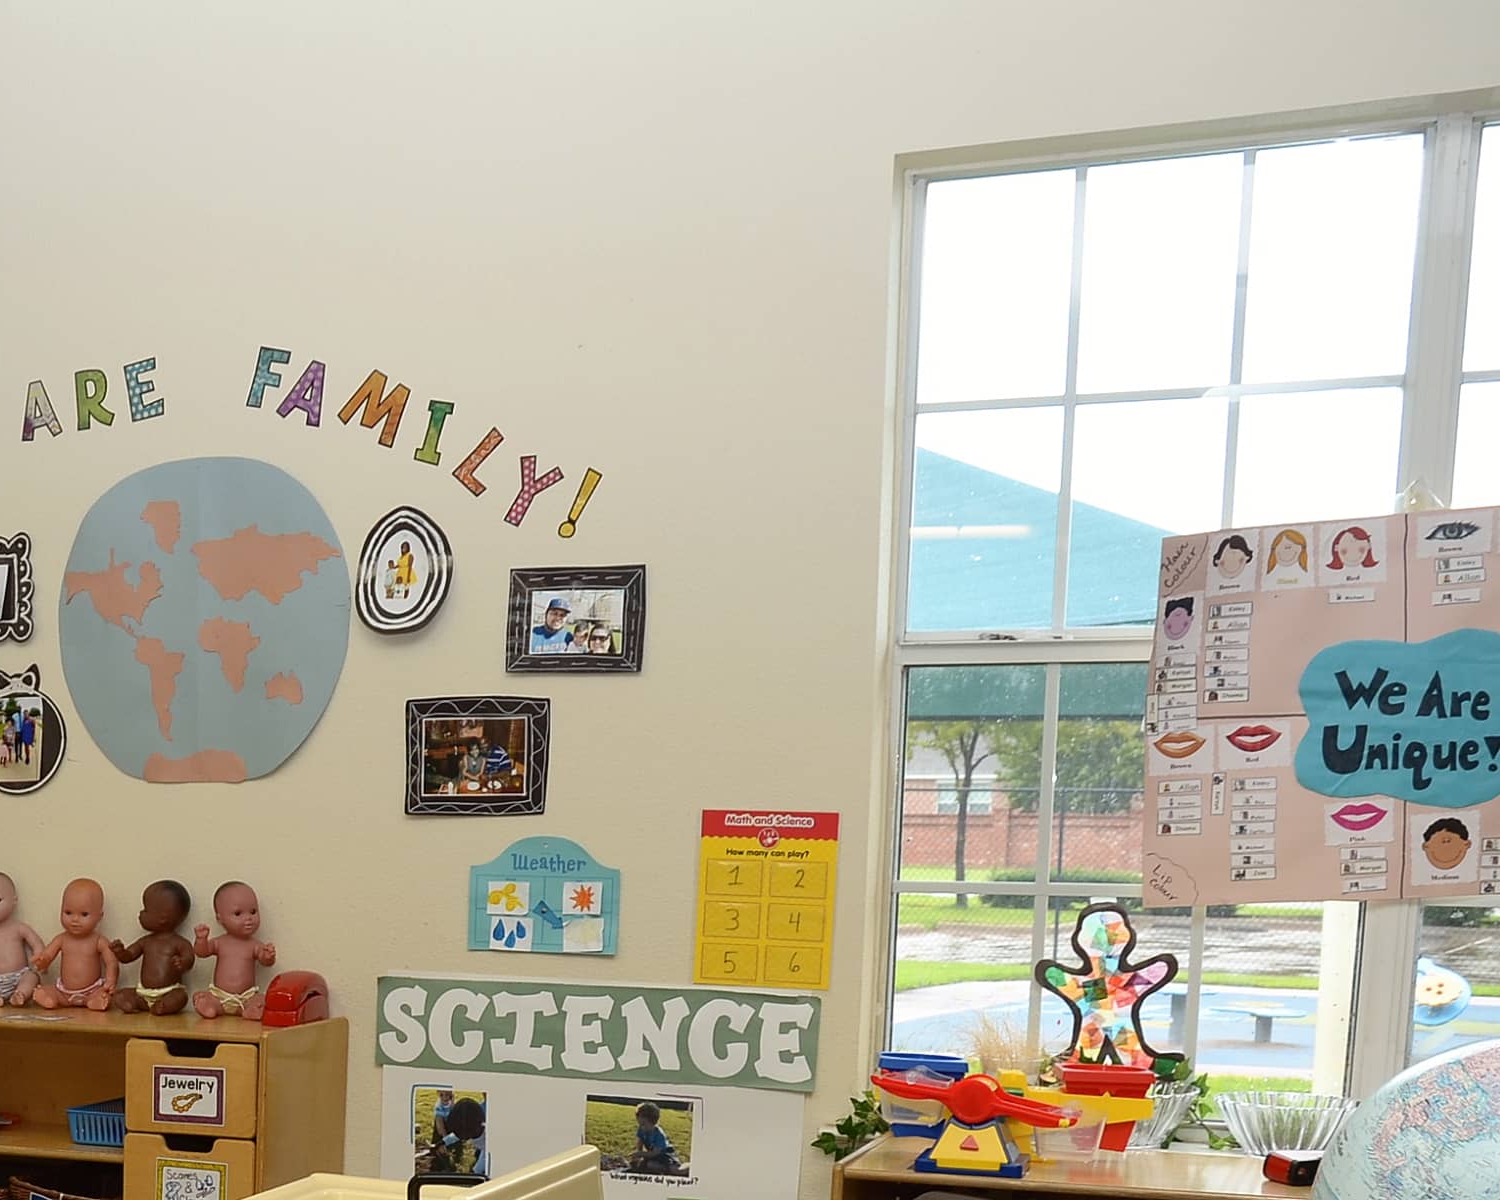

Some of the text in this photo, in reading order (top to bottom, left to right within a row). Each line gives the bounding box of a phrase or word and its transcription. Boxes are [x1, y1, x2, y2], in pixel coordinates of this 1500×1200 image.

[21, 356, 166, 442] ARE
[246, 346, 602, 539] FAMILY!
[1334, 667, 1491, 721] We Are
[1321, 724, 1500, 790] Unique!
[726, 815, 813, 827] Math and Science
[511, 853, 587, 874] Weather
[726, 848, 744, 856] How
[746, 849, 768, 858] many
[787, 850, 810, 859] play?
[728, 865, 805, 888] 1 2
[725, 908, 801, 932] 3 4
[724, 951, 801, 974] 5 6
[378, 985, 814, 1084] SCIENCE
[161, 1076, 215, 1093] Jewelry
